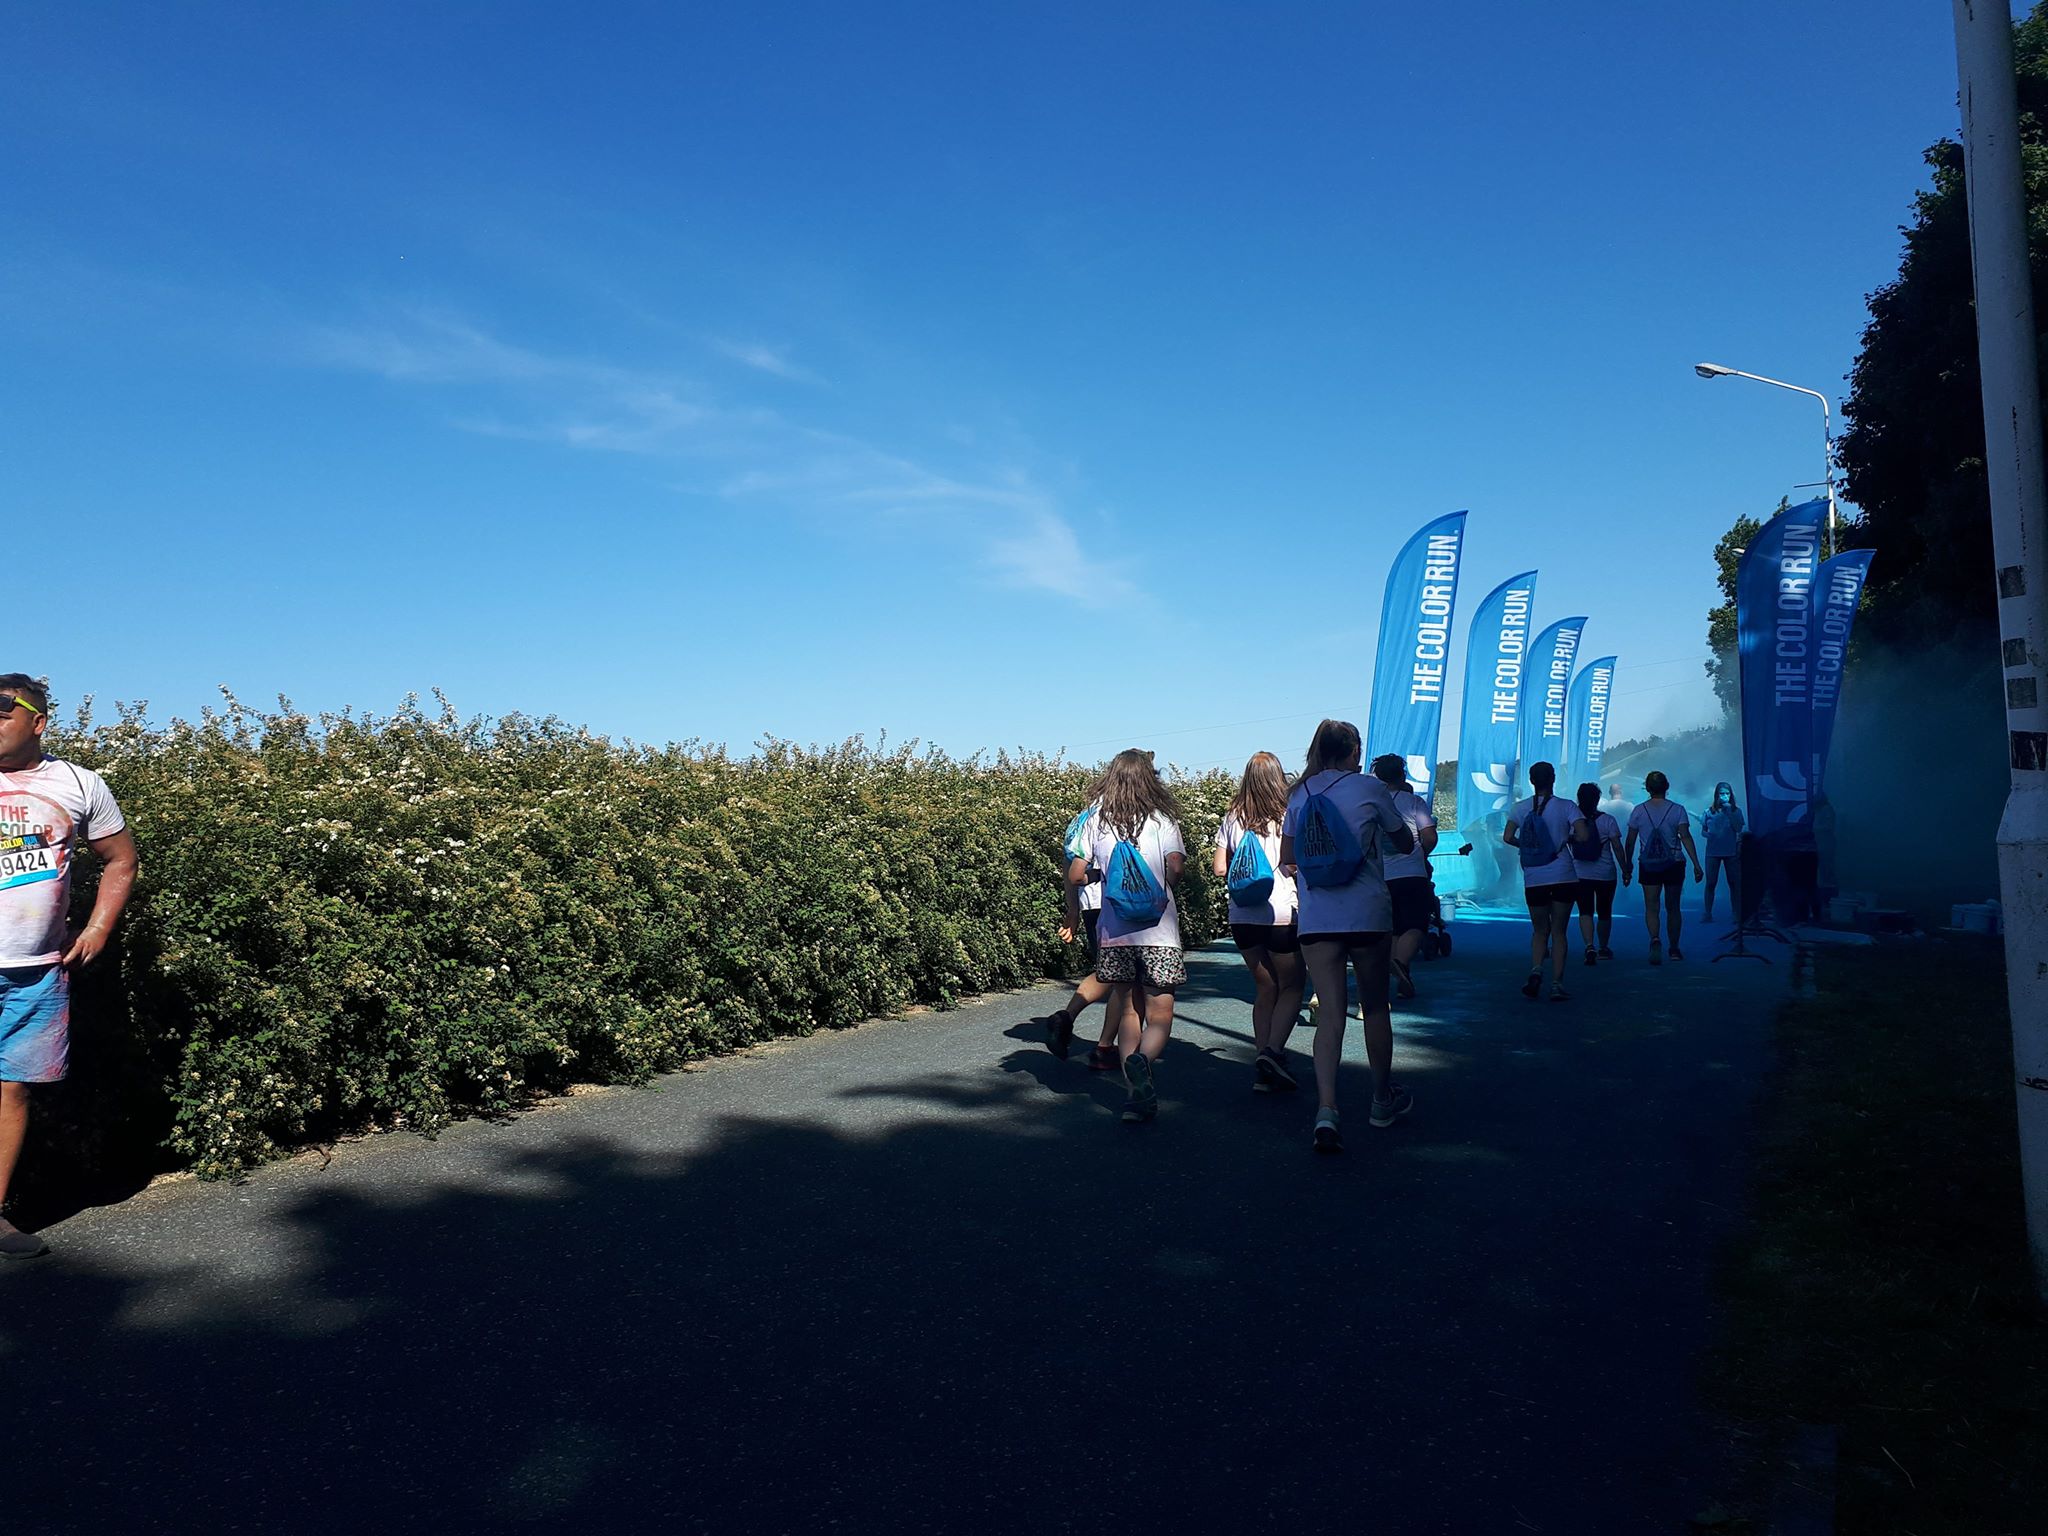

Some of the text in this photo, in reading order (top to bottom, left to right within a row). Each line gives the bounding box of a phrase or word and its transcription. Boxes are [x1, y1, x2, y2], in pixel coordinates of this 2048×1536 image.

[1415, 585, 1452, 660] COLOR
[1776, 577, 1810, 658] COLOR
[1494, 629, 1524, 689] COLOR
[1817, 607, 1850, 672] COLOR
[1410, 662, 1443, 705] THE
[1546, 659, 1571, 708] COLOR
[1775, 662, 1806, 707] THE
[1812, 674, 1838, 710] THE
[1491, 690, 1518, 724] THE
[1543, 710, 1563, 738] THE
[1588, 695, 1607, 738] COLOR
[1587, 740, 1601, 763] THE
[0, 804, 30, 823] THE
[0, 850, 48, 877] 9424
